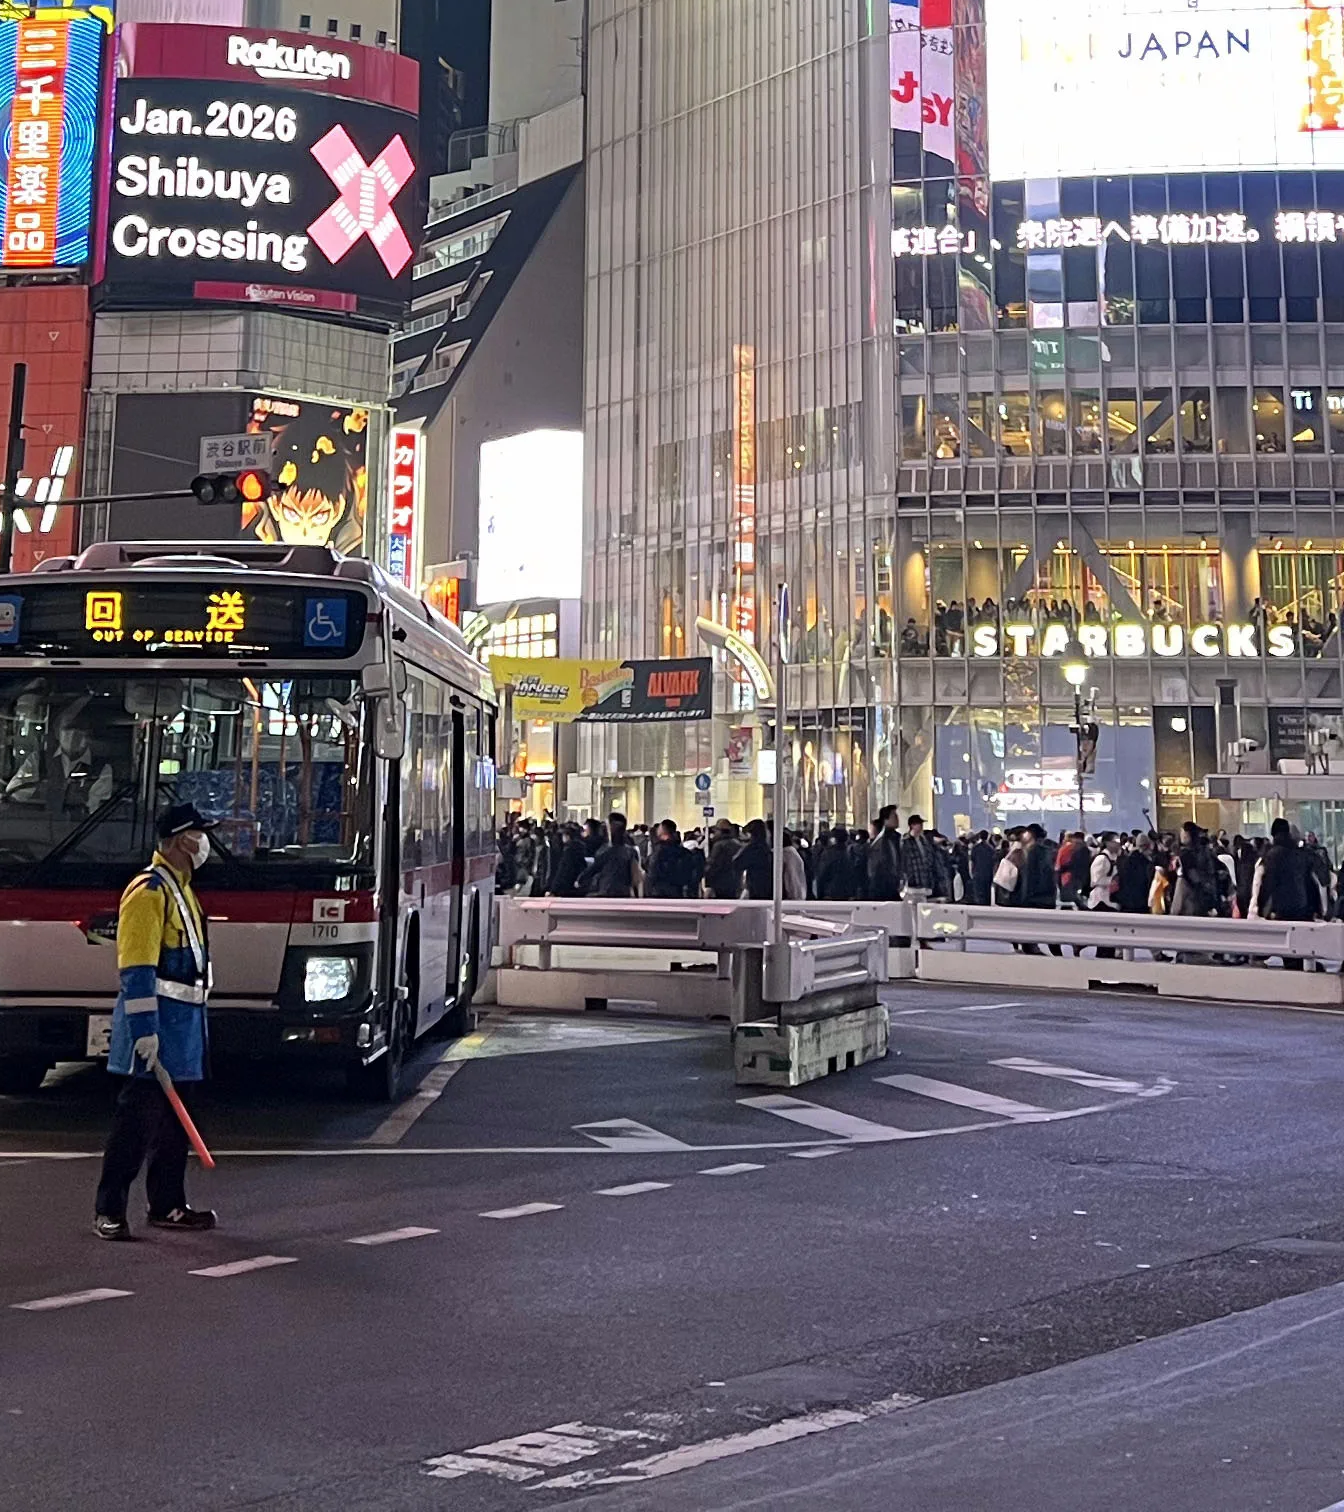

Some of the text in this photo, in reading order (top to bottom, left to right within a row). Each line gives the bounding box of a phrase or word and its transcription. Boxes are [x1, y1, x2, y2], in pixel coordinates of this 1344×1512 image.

[227, 35, 350, 81] Rakuten
[1117, 28, 1251, 61] JAPAN
[204, 100, 298, 143] 2026
[7, 28, 57, 253] 三千里薬品
[115, 154, 292, 207] Shibuya
[112, 214, 309, 272] Crossing
[283, 288, 316, 303] Vision
[206, 438, 267, 459] 渋谷駅前
[393, 444, 414, 526] カラオ
[92, 629, 235, 643] OUT OF SERVICE
[973, 623, 1296, 658] STARBUCKS
[647, 670, 700, 698] ALVARK
[311, 924, 339, 939] 1710
